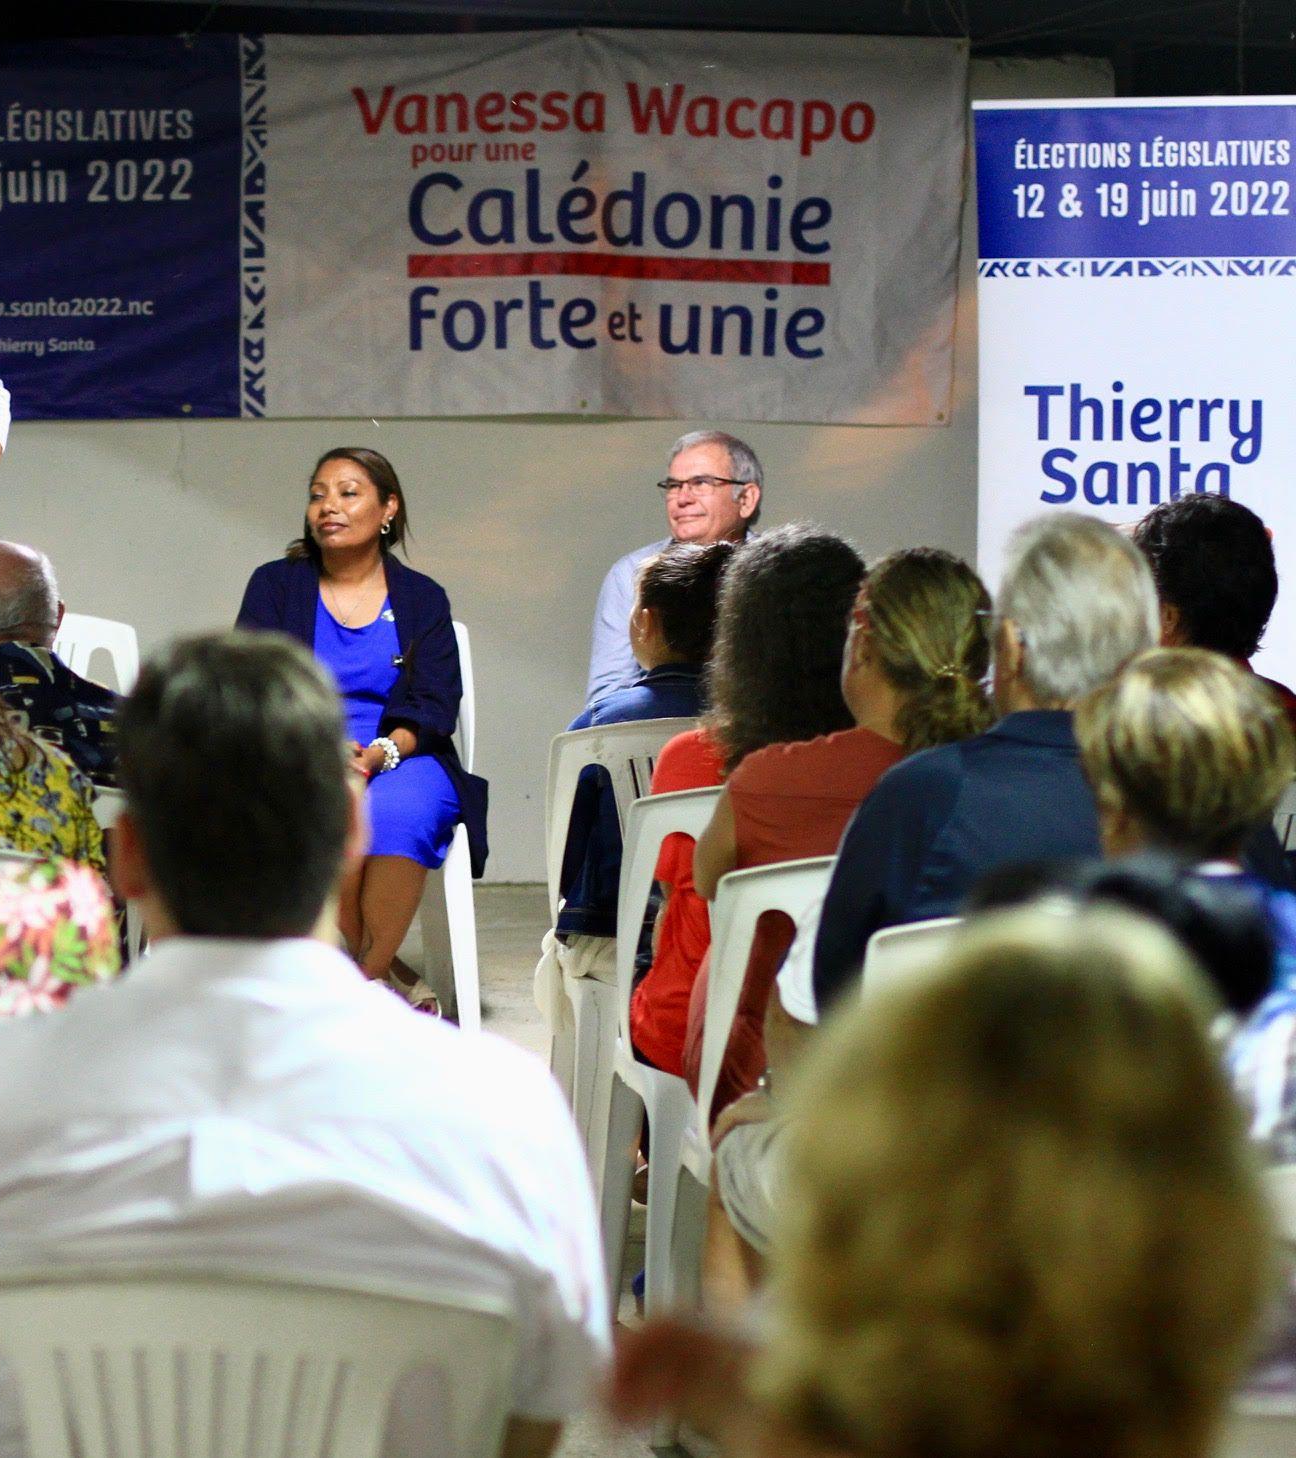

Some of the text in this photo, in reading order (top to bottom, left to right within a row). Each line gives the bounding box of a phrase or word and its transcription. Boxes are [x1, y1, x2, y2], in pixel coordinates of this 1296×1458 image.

[352, 82, 876, 157] Vanessa Wacapo
[411, 141, 537, 169] pour une
[1015, 135, 1291, 170] ÉLECTIONS LÉGISLATIVES
[86, 158, 194, 203] 2022
[1012, 180, 1290, 226] 12 & 19 juin 2022
[408, 159, 833, 255] Calédonie
[48, 337, 96, 352] Santa
[409, 281, 826, 360] forte et unie
[1023, 380, 1263, 465] Thierry
[1040, 447, 1231, 505] Santa
